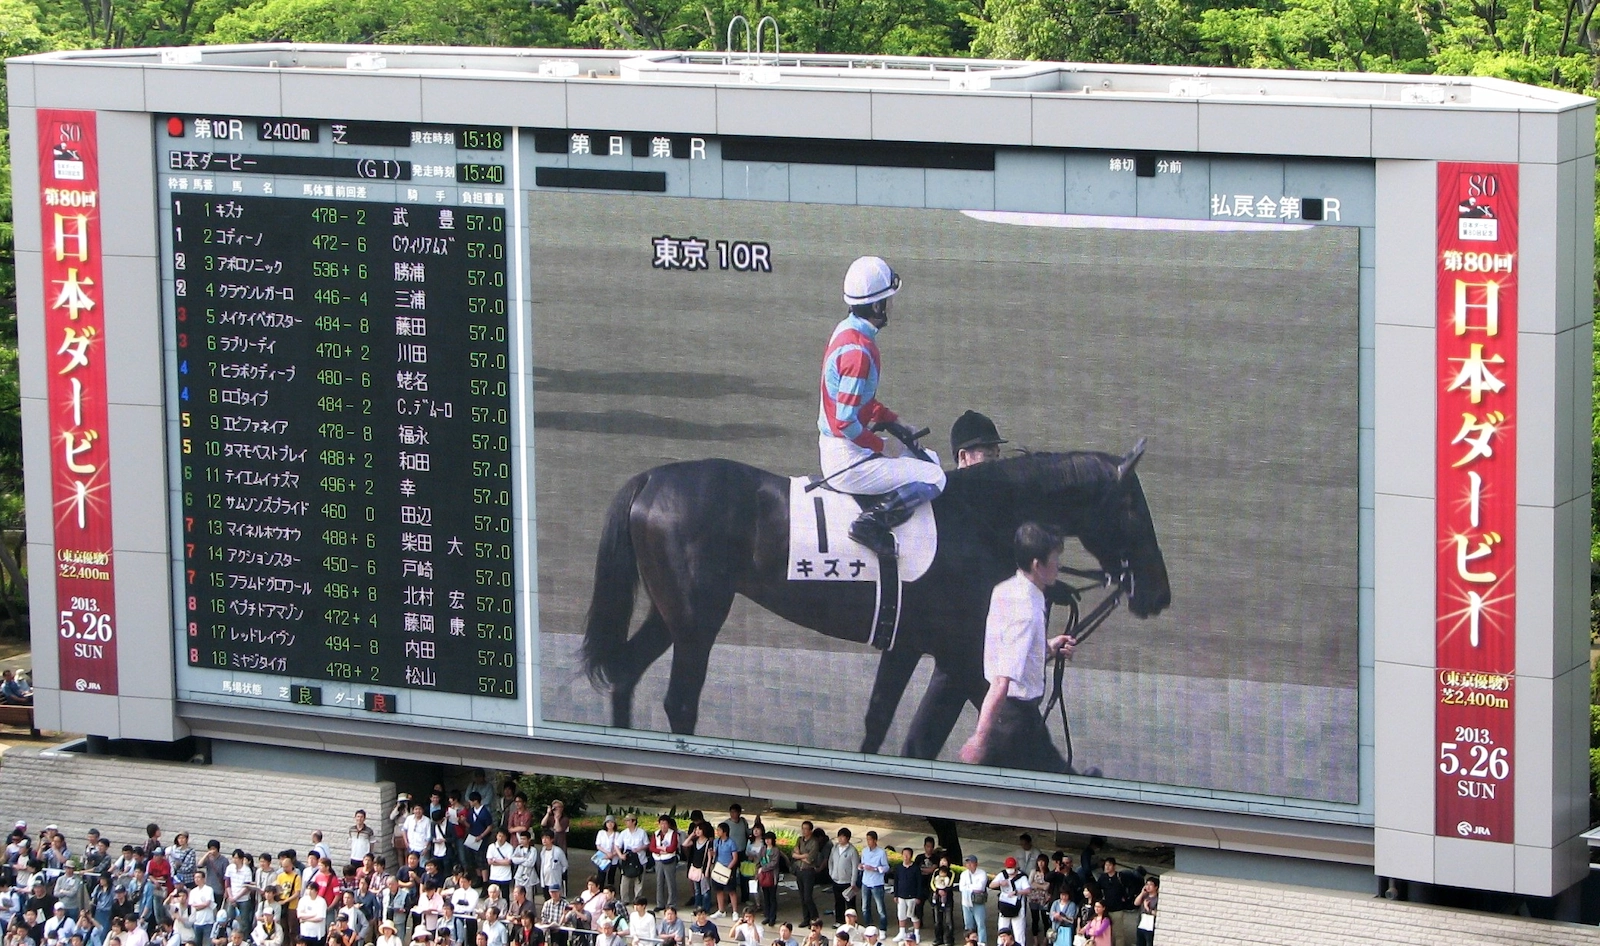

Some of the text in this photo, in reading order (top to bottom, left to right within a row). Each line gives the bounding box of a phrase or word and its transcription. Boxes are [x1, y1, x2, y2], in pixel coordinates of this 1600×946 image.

[59, 123, 81, 143] 80
[263, 122, 310, 141] 2400m
[331, 125, 348, 144] 芝
[411, 132, 454, 145] 現在時刻
[462, 130, 502, 149] 15:18
[571, 133, 706, 160] 第 日 第 R
[170, 151, 257, 170] 日本ダービー
[412, 165, 455, 178] 発走時刻
[463, 165, 503, 183] 15:40
[45, 188, 97, 208] 第80回
[462, 191, 505, 205] 負担重量
[1468, 174, 1497, 197] 80
[204, 202, 209, 216] 1
[215, 200, 244, 218] キズナ
[392, 206, 409, 227] 武
[438, 209, 455, 229] 豊
[466, 215, 501, 232] 57.0
[203, 228, 212, 243] 2
[215, 227, 262, 246] コディーノ
[467, 242, 502, 259] 57.0
[653, 238, 771, 271] 東京 10R
[174, 252, 503, 287] 2 3 アポロソニック 勝浦 57.0
[1443, 250, 1513, 273] 第80回
[175, 278, 503, 314] 2 4 クラウンレガーロ 三浦 57.0
[206, 308, 215, 323] 5
[219, 310, 302, 328] メイケイペガスター
[395, 316, 426, 336] 藤田
[469, 324, 504, 342] 57.0
[207, 335, 216, 350] 6
[220, 335, 276, 354] ラブリーデイ
[397, 342, 427, 363] 川田
[470, 352, 505, 369] 57.0
[51, 213, 98, 528] 日本ダービー
[179, 360, 188, 374] 4
[208, 361, 216, 376] 7
[220, 363, 295, 382] ヒラボクディープ
[470, 379, 506, 397] 57.0
[180, 386, 189, 401] 4
[209, 388, 217, 403] 8
[221, 387, 268, 406] ロゴタイプ
[471, 406, 506, 424] 57.0
[181, 412, 507, 451] 5 9 エピファネイア 福永 57.0
[182, 438, 508, 478] 5 10 タマモベストプレイ 和田 57.0
[1447, 279, 1506, 647] 日本ダービー
[205, 467, 218, 482] 11
[224, 469, 299, 488] テイエムイナズマ
[399, 478, 416, 497] 幸
[473, 488, 508, 505] 57.0
[207, 493, 221, 508] 12
[225, 495, 309, 515] サムソンズプライド
[321, 503, 346, 519] 460
[365, 506, 374, 521] 0
[401, 505, 432, 526] 田辺
[474, 515, 509, 532] 57.0
[185, 517, 510, 559] 7 13 マイネルホウオウ 柴田 大 57.0
[186, 543, 510, 586] 7 14 アクションスター 戸崎 57.0
[797, 558, 866, 578] キズナ
[71, 596, 100, 612] 2013.
[187, 569, 511, 614] 7 15 フラムドグロワール 北村 宏 57.0
[60, 610, 112, 642] 5.26
[188, 596, 196, 610] 8
[210, 598, 225, 613] 16
[229, 599, 303, 620] ペプチドアマゾン
[477, 623, 512, 641] 57.0
[74, 643, 103, 659] SUN
[189, 622, 512, 667] 8 17 レッドレイヴン 内田 57.0
[190, 648, 513, 694] 8 18 ミヤジタイガ 松山 57.0
[222, 681, 387, 712] 馬場状態 芝 良 ダート 良
[1455, 726, 1493, 745] 2013.
[1440, 742, 1509, 780] 5.26
[1457, 780, 1496, 800] SUN
[1473, 826, 1491, 836] JRA
